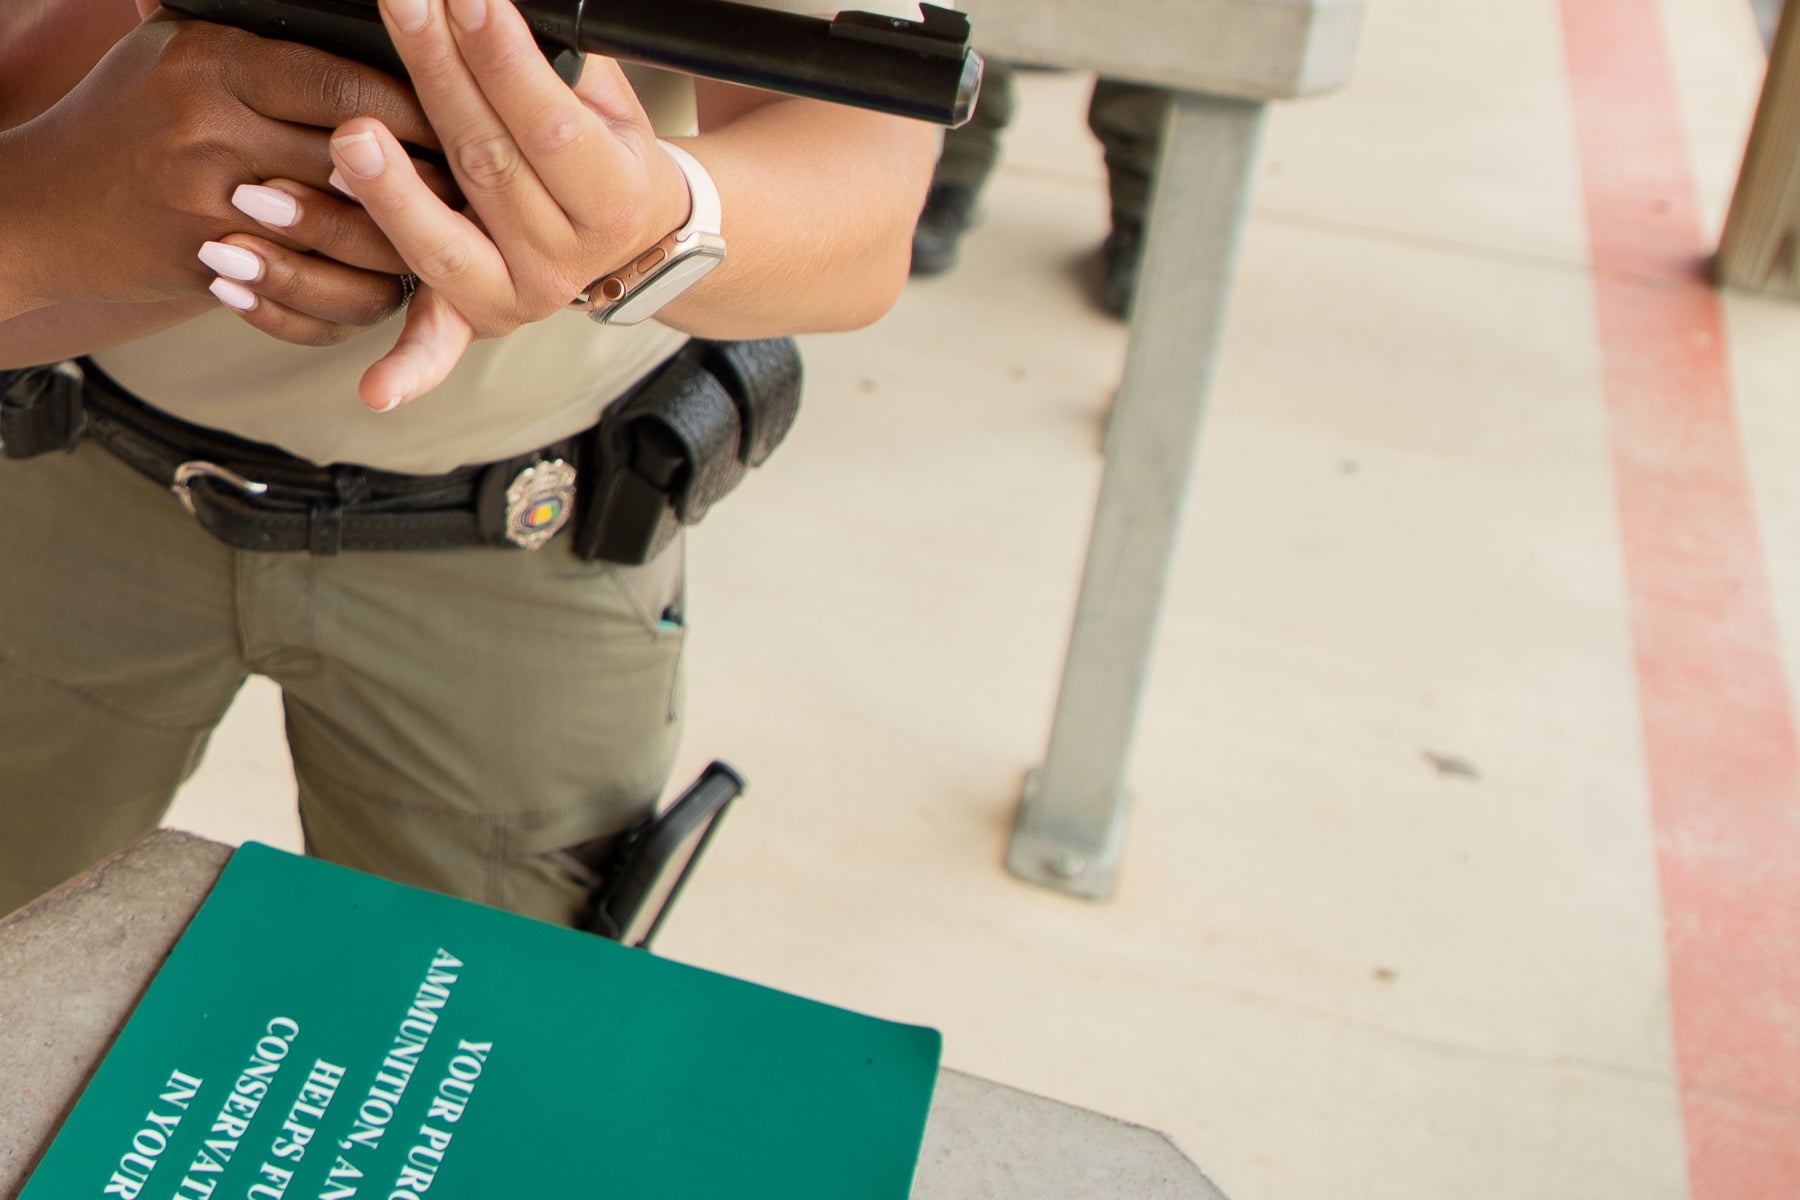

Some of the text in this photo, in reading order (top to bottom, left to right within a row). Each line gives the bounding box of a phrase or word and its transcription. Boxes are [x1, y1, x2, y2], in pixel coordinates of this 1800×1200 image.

[337, 947, 464, 1151] AMMUNITION,
[427, 1038, 494, 1124] YOUR
[103, 1068, 204, 1200] IN YOUR
[271, 1058, 347, 1163] HELPS
